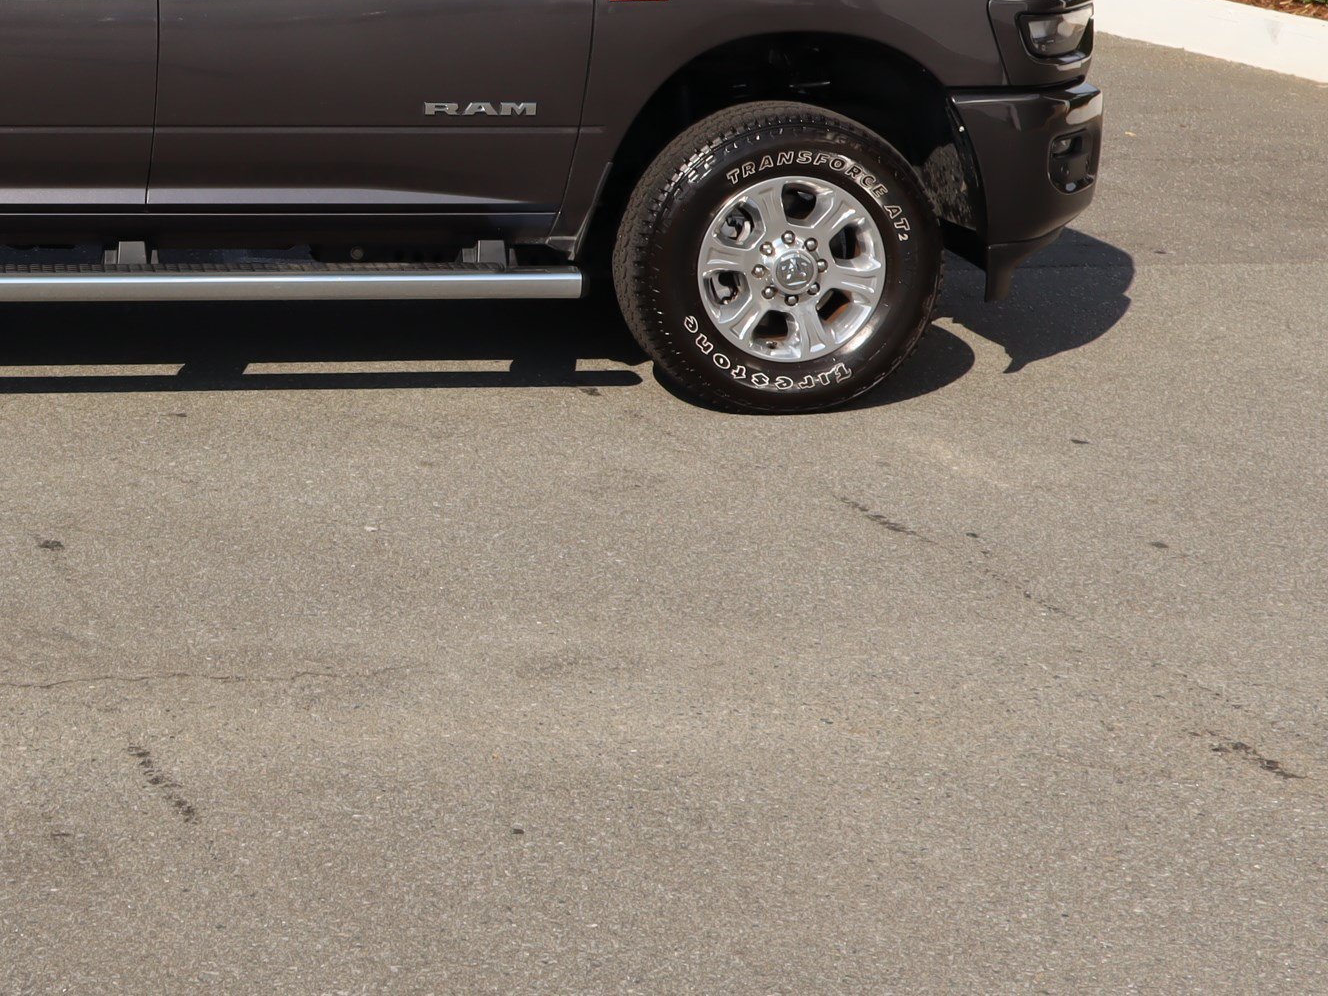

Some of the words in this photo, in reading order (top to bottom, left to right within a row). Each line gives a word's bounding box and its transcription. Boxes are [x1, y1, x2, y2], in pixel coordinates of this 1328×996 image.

[424, 102, 537, 116] RAM
[726, 151, 888, 198] TRANSFORCE
[684, 315, 853, 391] Firestone
